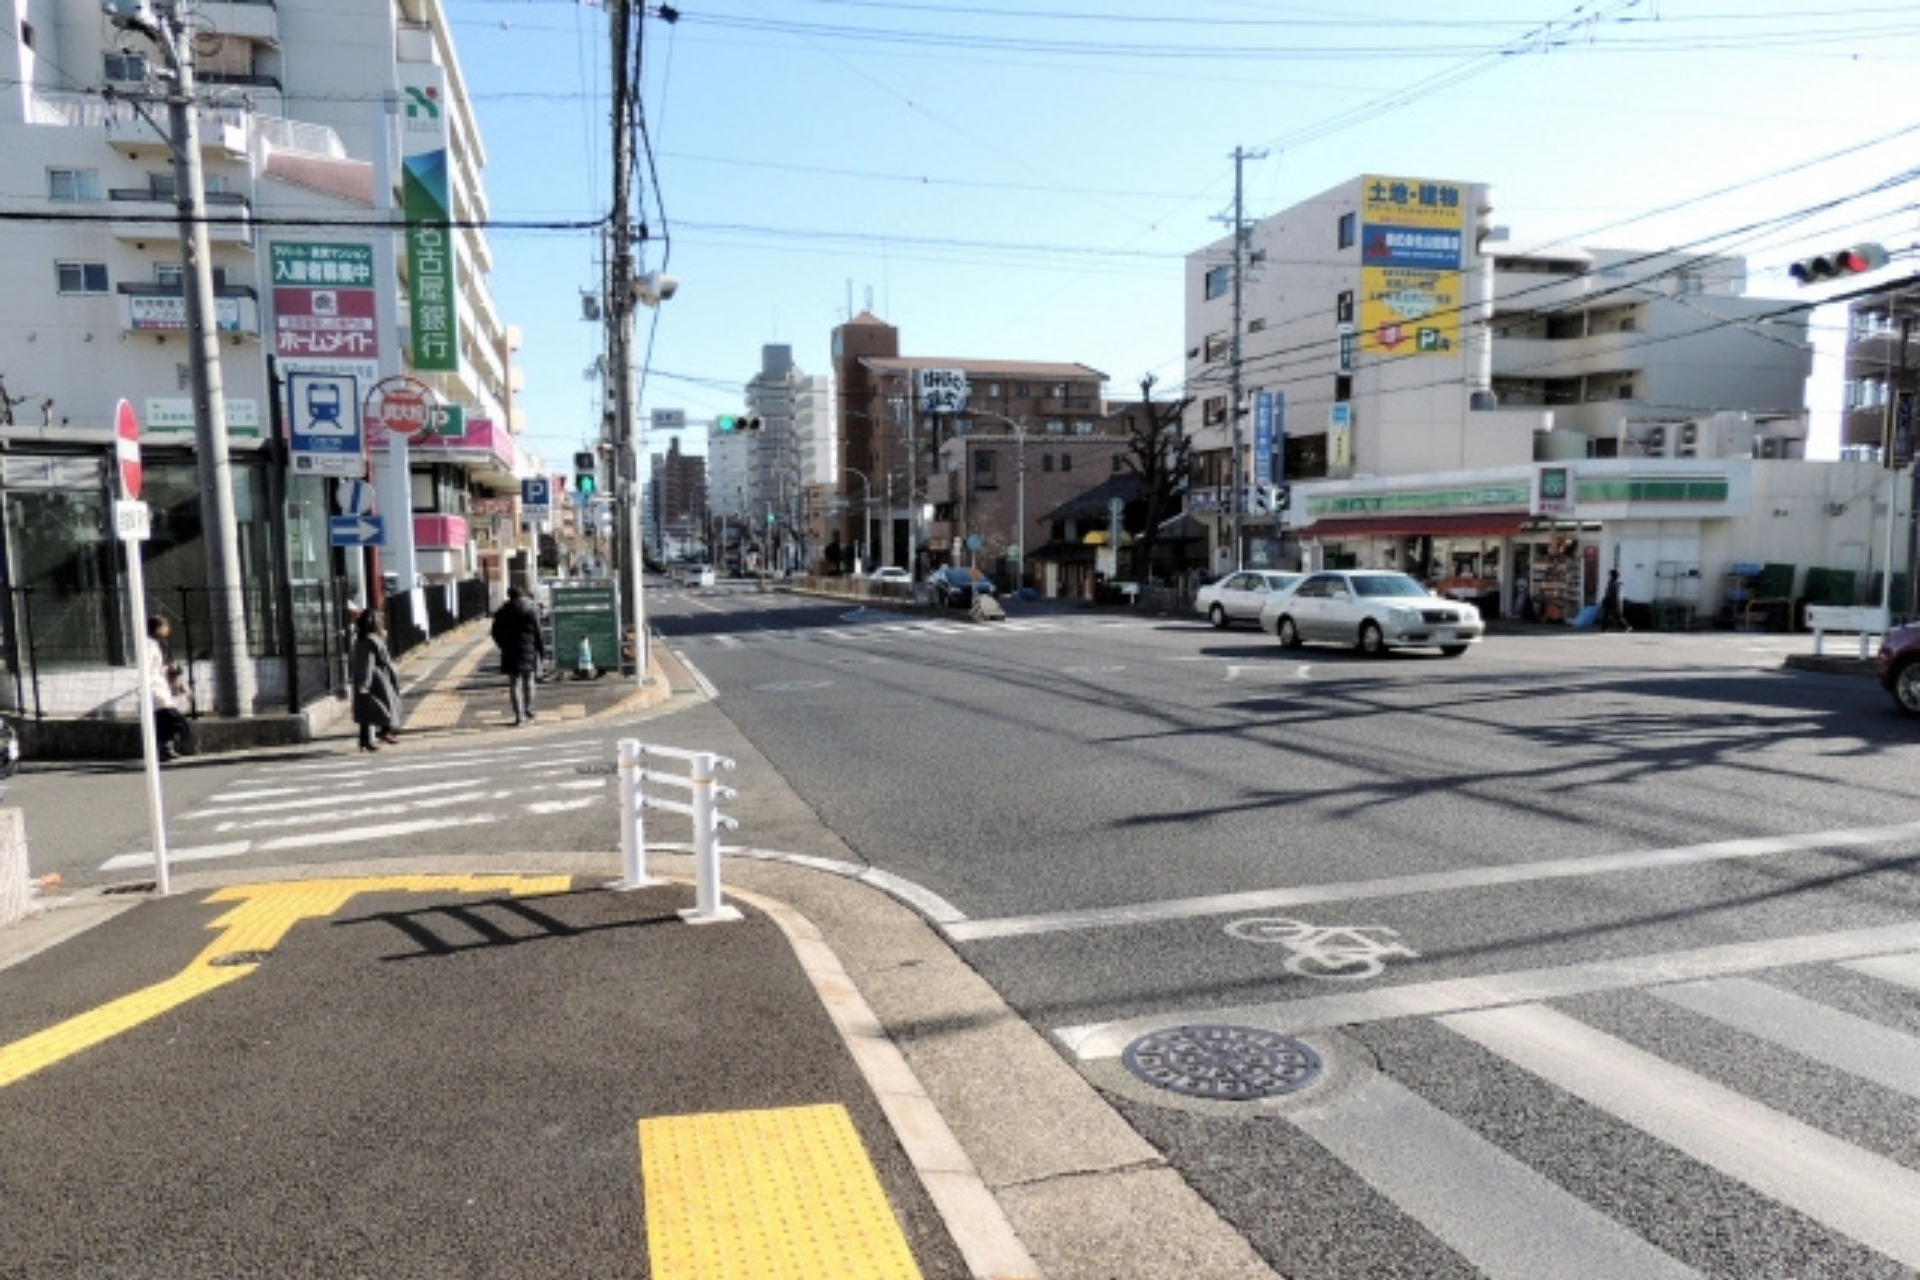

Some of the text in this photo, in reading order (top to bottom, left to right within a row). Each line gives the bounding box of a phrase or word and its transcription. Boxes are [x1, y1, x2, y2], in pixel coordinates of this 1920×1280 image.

[1367, 180, 1459, 207] 土地・建物
[275, 260, 370, 283] 入居者募集中
[278, 330, 373, 352] ホームメイト
[528, 482, 543, 501] P
